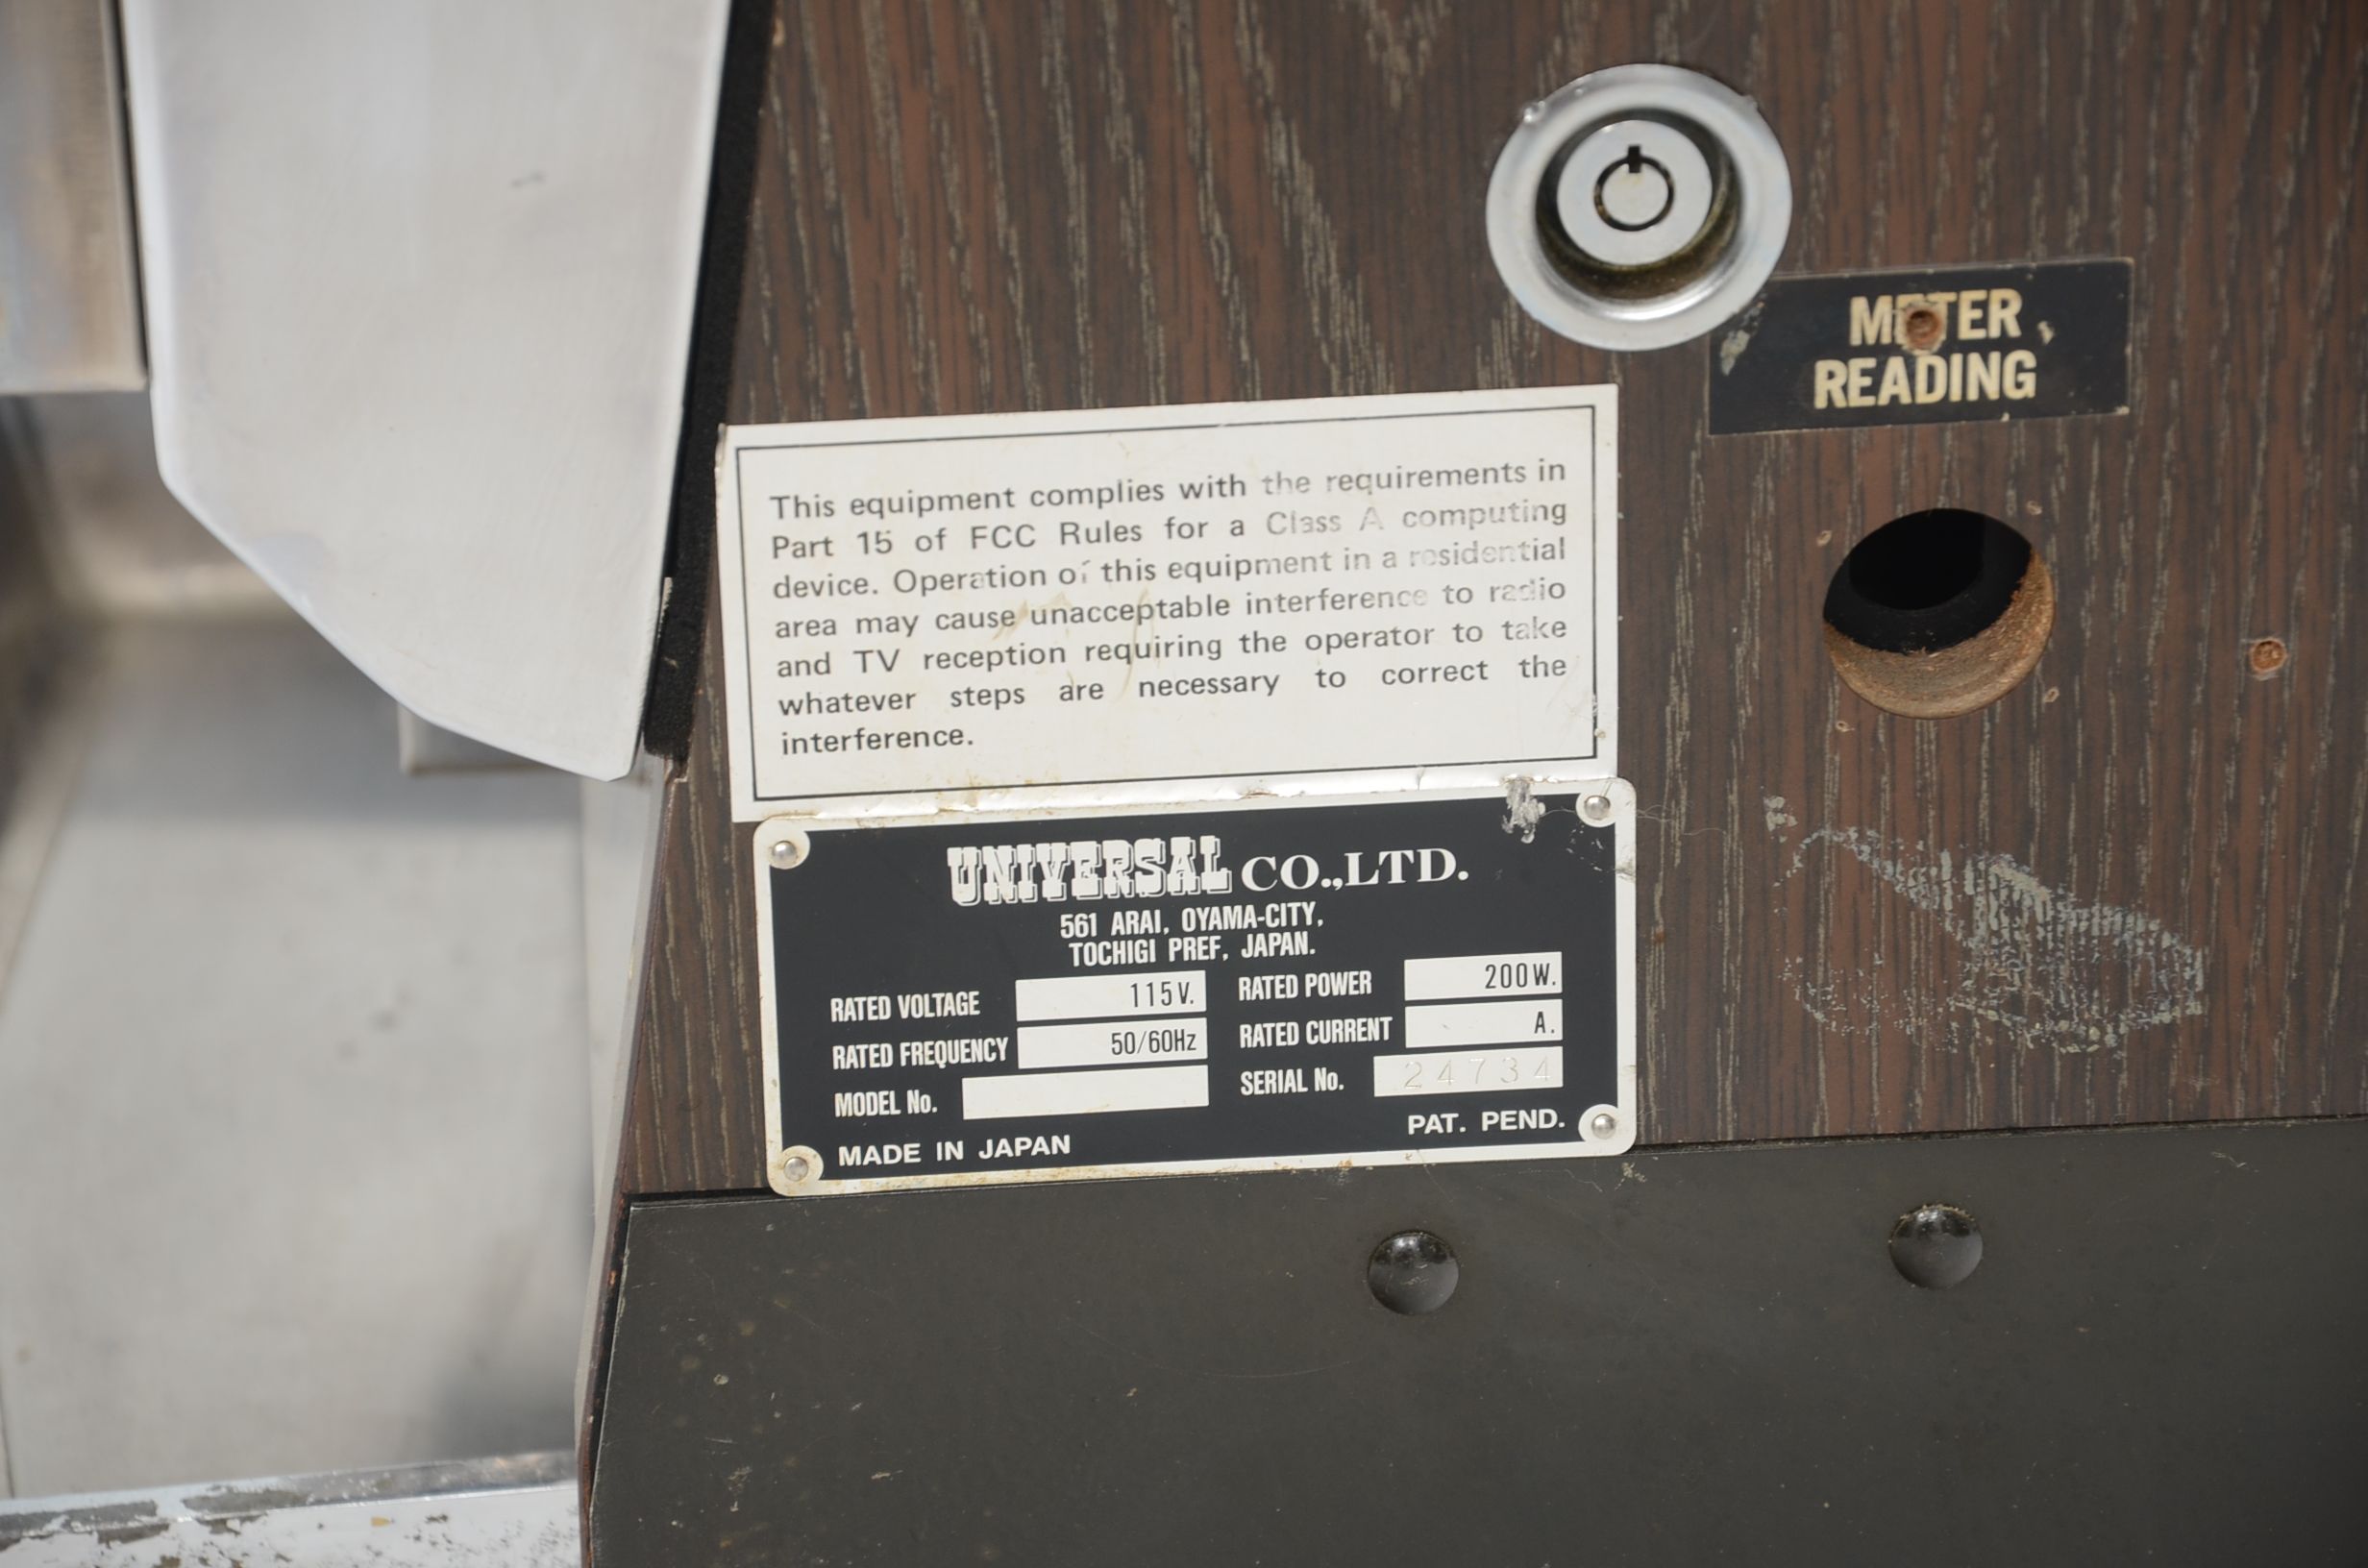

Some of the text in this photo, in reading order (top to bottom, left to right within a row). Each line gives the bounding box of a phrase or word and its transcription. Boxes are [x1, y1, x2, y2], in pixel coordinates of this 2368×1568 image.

[1813, 350, 2036, 409] READING
[770, 458, 1566, 520] This equipment complies with the requirements in
[772, 502, 1566, 559] Part 15 of FCC Rules for a Class A computing
[773, 575, 879, 600] device.
[894, 565, 1047, 597] Operation
[1101, 558, 1156, 582] this
[1168, 550, 1332, 582] equipment
[1344, 548, 1371, 572] in
[1382, 550, 1398, 569] a
[1410, 536, 1566, 569] residential
[775, 576, 1566, 639] area may cause unacceptable interference to radio
[777, 616, 1566, 677] and TV reception requiring the operator to take
[778, 654, 1566, 716] whatever steps are necessary to correct the
[781, 725, 974, 756] interference.
[947, 835, 1232, 907] UNIVERSAL
[1060, 901, 1324, 940] 561 ARAI, OYAMA-CITY,
[1069, 931, 1316, 967] TOCHIGI PREF, JAPAN.
[830, 980, 1195, 1023] RATED VOLTAGE 115V.
[1239, 962, 1557, 1001] RATED POWER 200W.
[832, 1028, 1197, 1070] RATED FREQUENCY 50/60Hz
[1239, 1010, 1556, 1048] RATED CURRENT A.
[1240, 1056, 1550, 1096] SERIAL No. 24734
[834, 1088, 938, 1118] MODEL No.
[1408, 1107, 1565, 1136] PAT. PEND.
[838, 1134, 1071, 1167] MADE IN JAPAN
